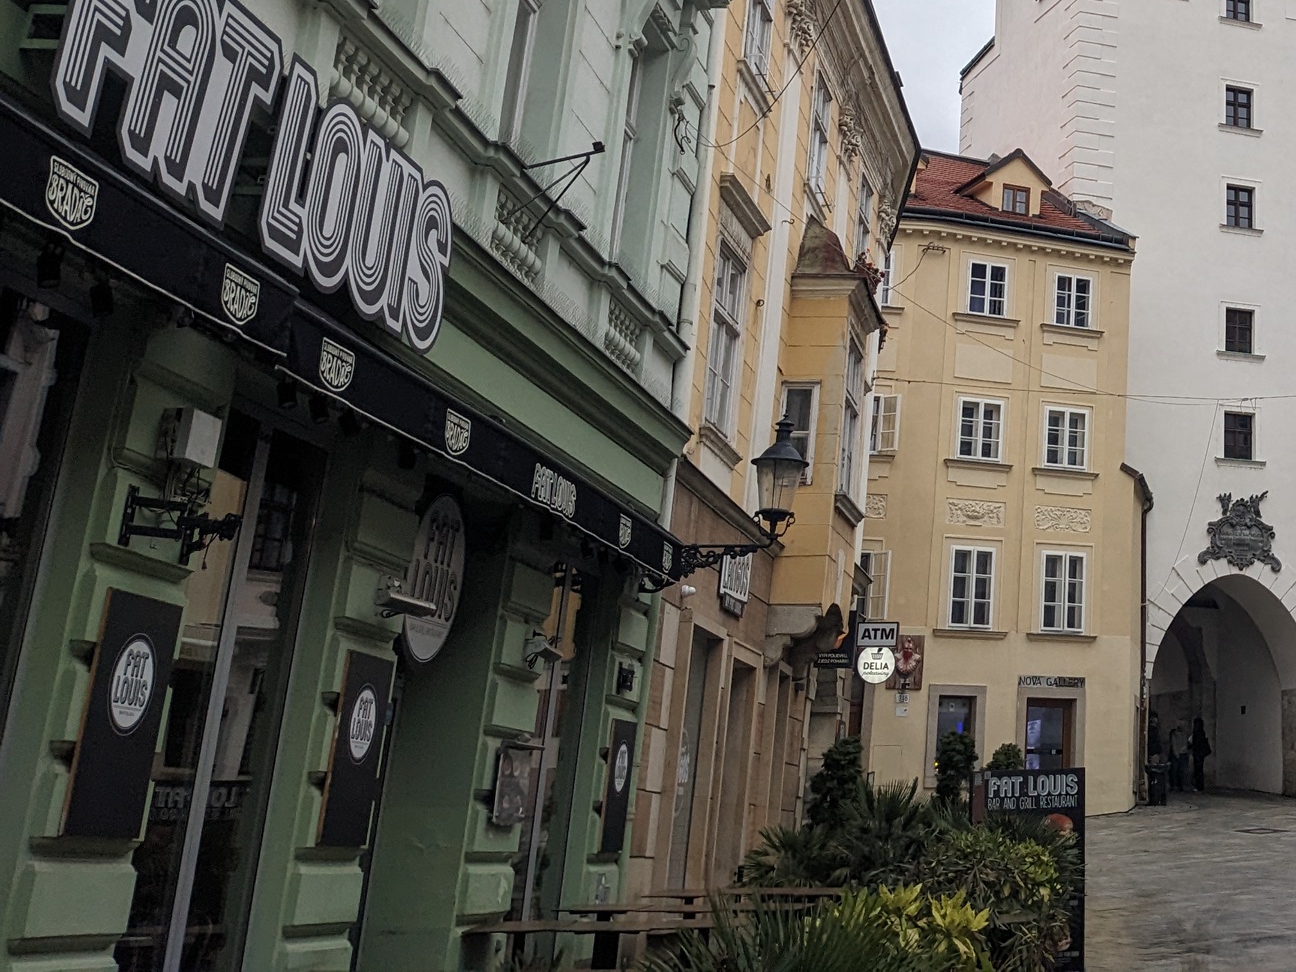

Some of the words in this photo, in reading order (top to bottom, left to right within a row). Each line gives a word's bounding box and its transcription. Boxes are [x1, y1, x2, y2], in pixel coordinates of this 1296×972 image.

[258, 55, 453, 354] LOUIS
[530, 462, 554, 504] FAT
[550, 472, 576, 518] LOUIS
[424, 510, 460, 568] FAT
[410, 558, 458, 622] LOUIS
[860, 628, 895, 640] ATM
[123, 649, 149, 679] FAT
[863, 662, 889, 670] DELIA
[113, 676, 148, 707] LOUIS
[1020, 676, 1042, 686] NOVA
[1046, 677, 1084, 687] GALLERY
[357, 696, 374, 719] FAT
[351, 717, 372, 742] LOUIS
[988, 776, 1023, 797] FAT
[1028, 774, 1078, 796] LOUIS
[988, 798, 1000, 810] BAR
[1003, 797, 1016, 809] AND
[1020, 796, 1037, 808] GRILL
[1040, 795, 1078, 808] RESTAURANT
